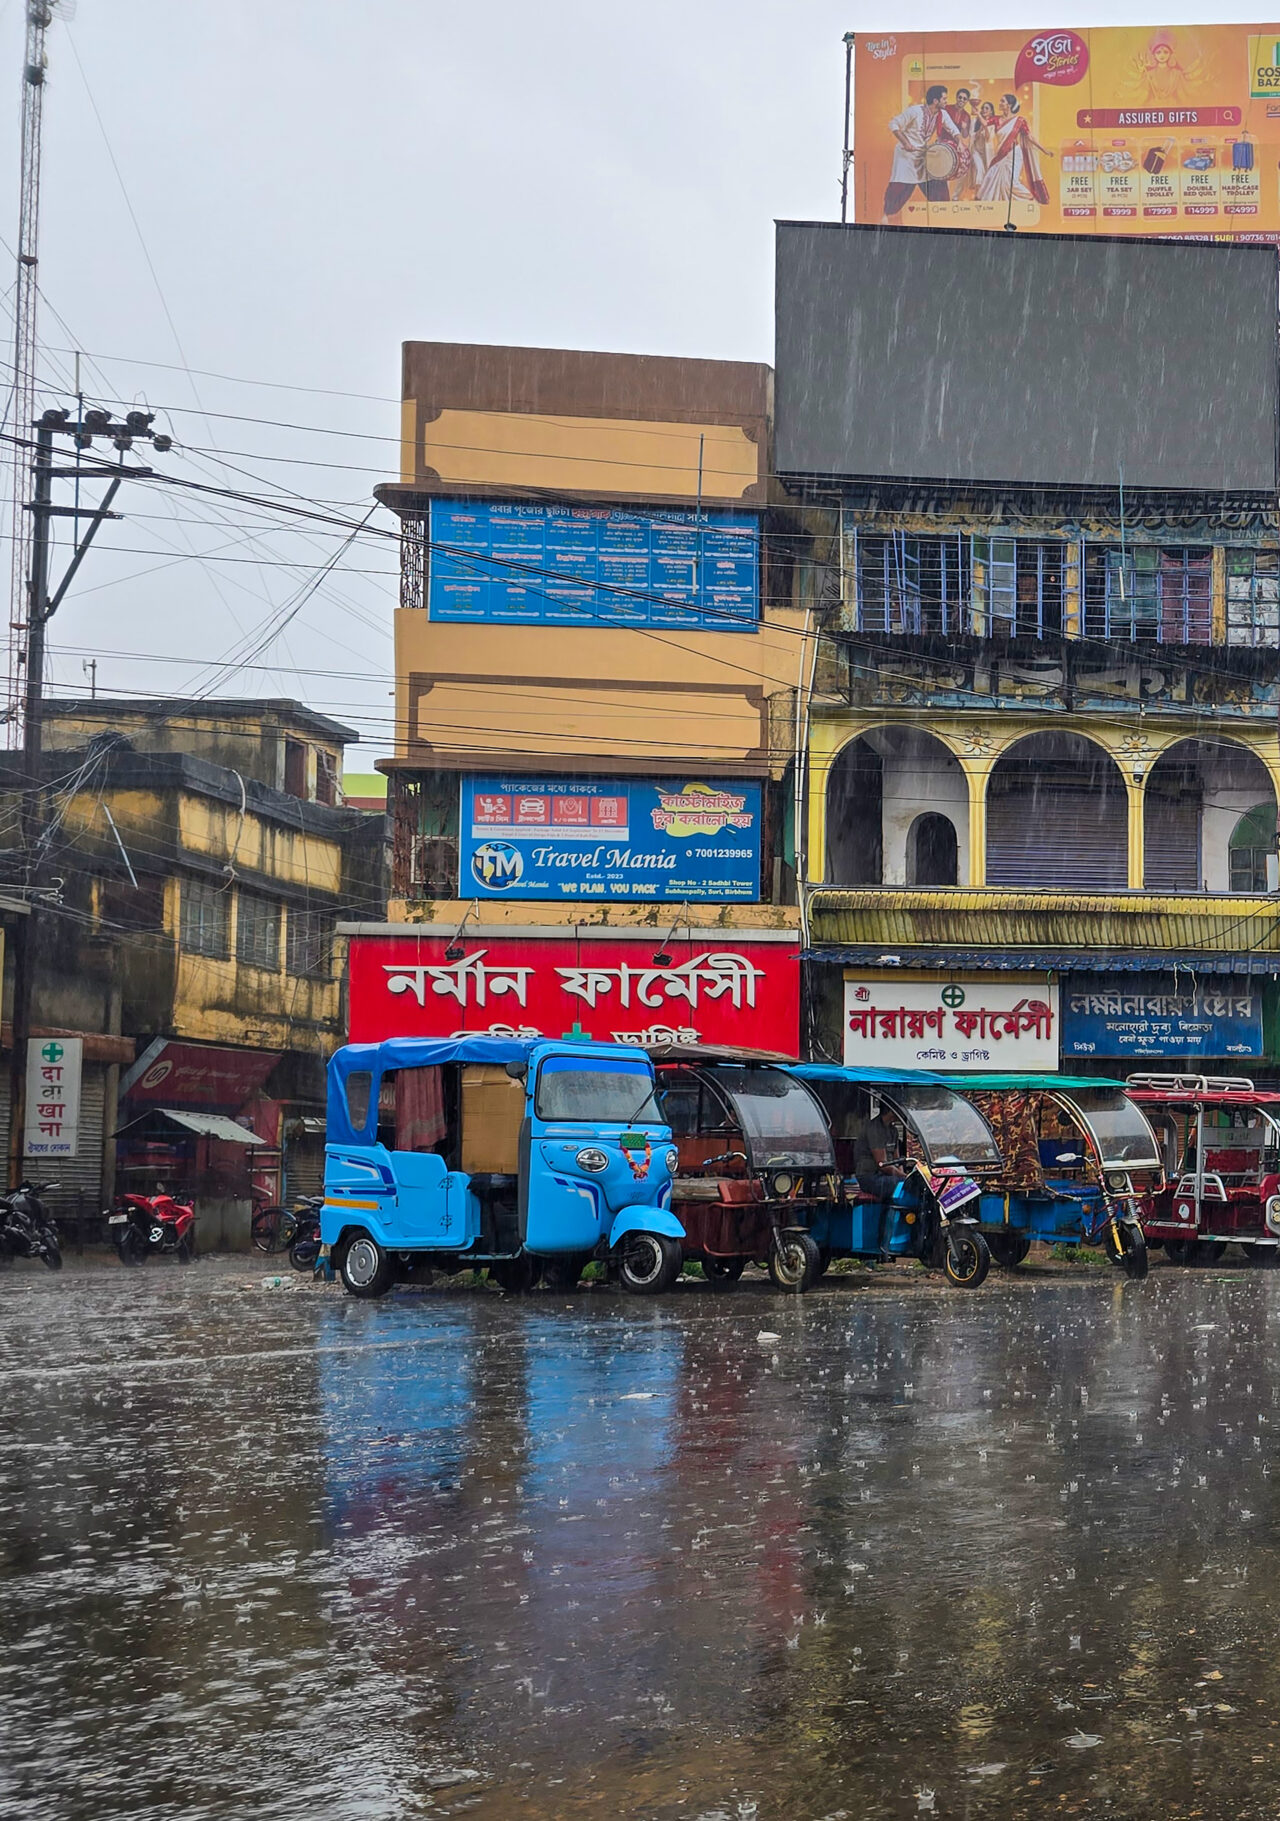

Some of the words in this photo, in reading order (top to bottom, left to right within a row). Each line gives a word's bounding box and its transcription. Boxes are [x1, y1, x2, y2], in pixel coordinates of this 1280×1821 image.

[1031, 34, 1072, 65] পুজো
[1047, 54, 1079, 71] Stories
[1119, 112, 1164, 124] ASSURED
[1168, 111, 1198, 123] GIFTS
[1071, 176, 1088, 185] FREE
[1110, 176, 1128, 185] FREE
[1150, 176, 1168, 185] FREE
[1191, 175, 1209, 184] FREE
[1231, 175, 1249, 184] FREE
[1214, 234, 1234, 242] SURI
[489, 505, 512, 514] এবার
[500, 783, 545, 793] প্যাকেজের
[547, 785, 566, 794] মধ্যে
[569, 785, 597, 794] থাকবে
[658, 792, 746, 810] কাস্টোমাইজ
[676, 811, 727, 827] করানো
[729, 812, 753, 828] হয়
[532, 846, 606, 869] Travel
[605, 848, 677, 869] Mania
[695, 849, 753, 858] 7001239965
[474, 851, 521, 877] TM
[610, 883, 629, 894] YOU
[669, 879, 686, 887] Shop
[382, 949, 535, 1007] নর্মান
[554, 952, 765, 1009] ফার্মেসী
[849, 1006, 946, 1039] নারায়ণ
[953, 999, 1054, 1040] ফার্মেসী
[1106, 1019, 1149, 1033] মনোহারী
[951, 1051, 958, 1059] ও
